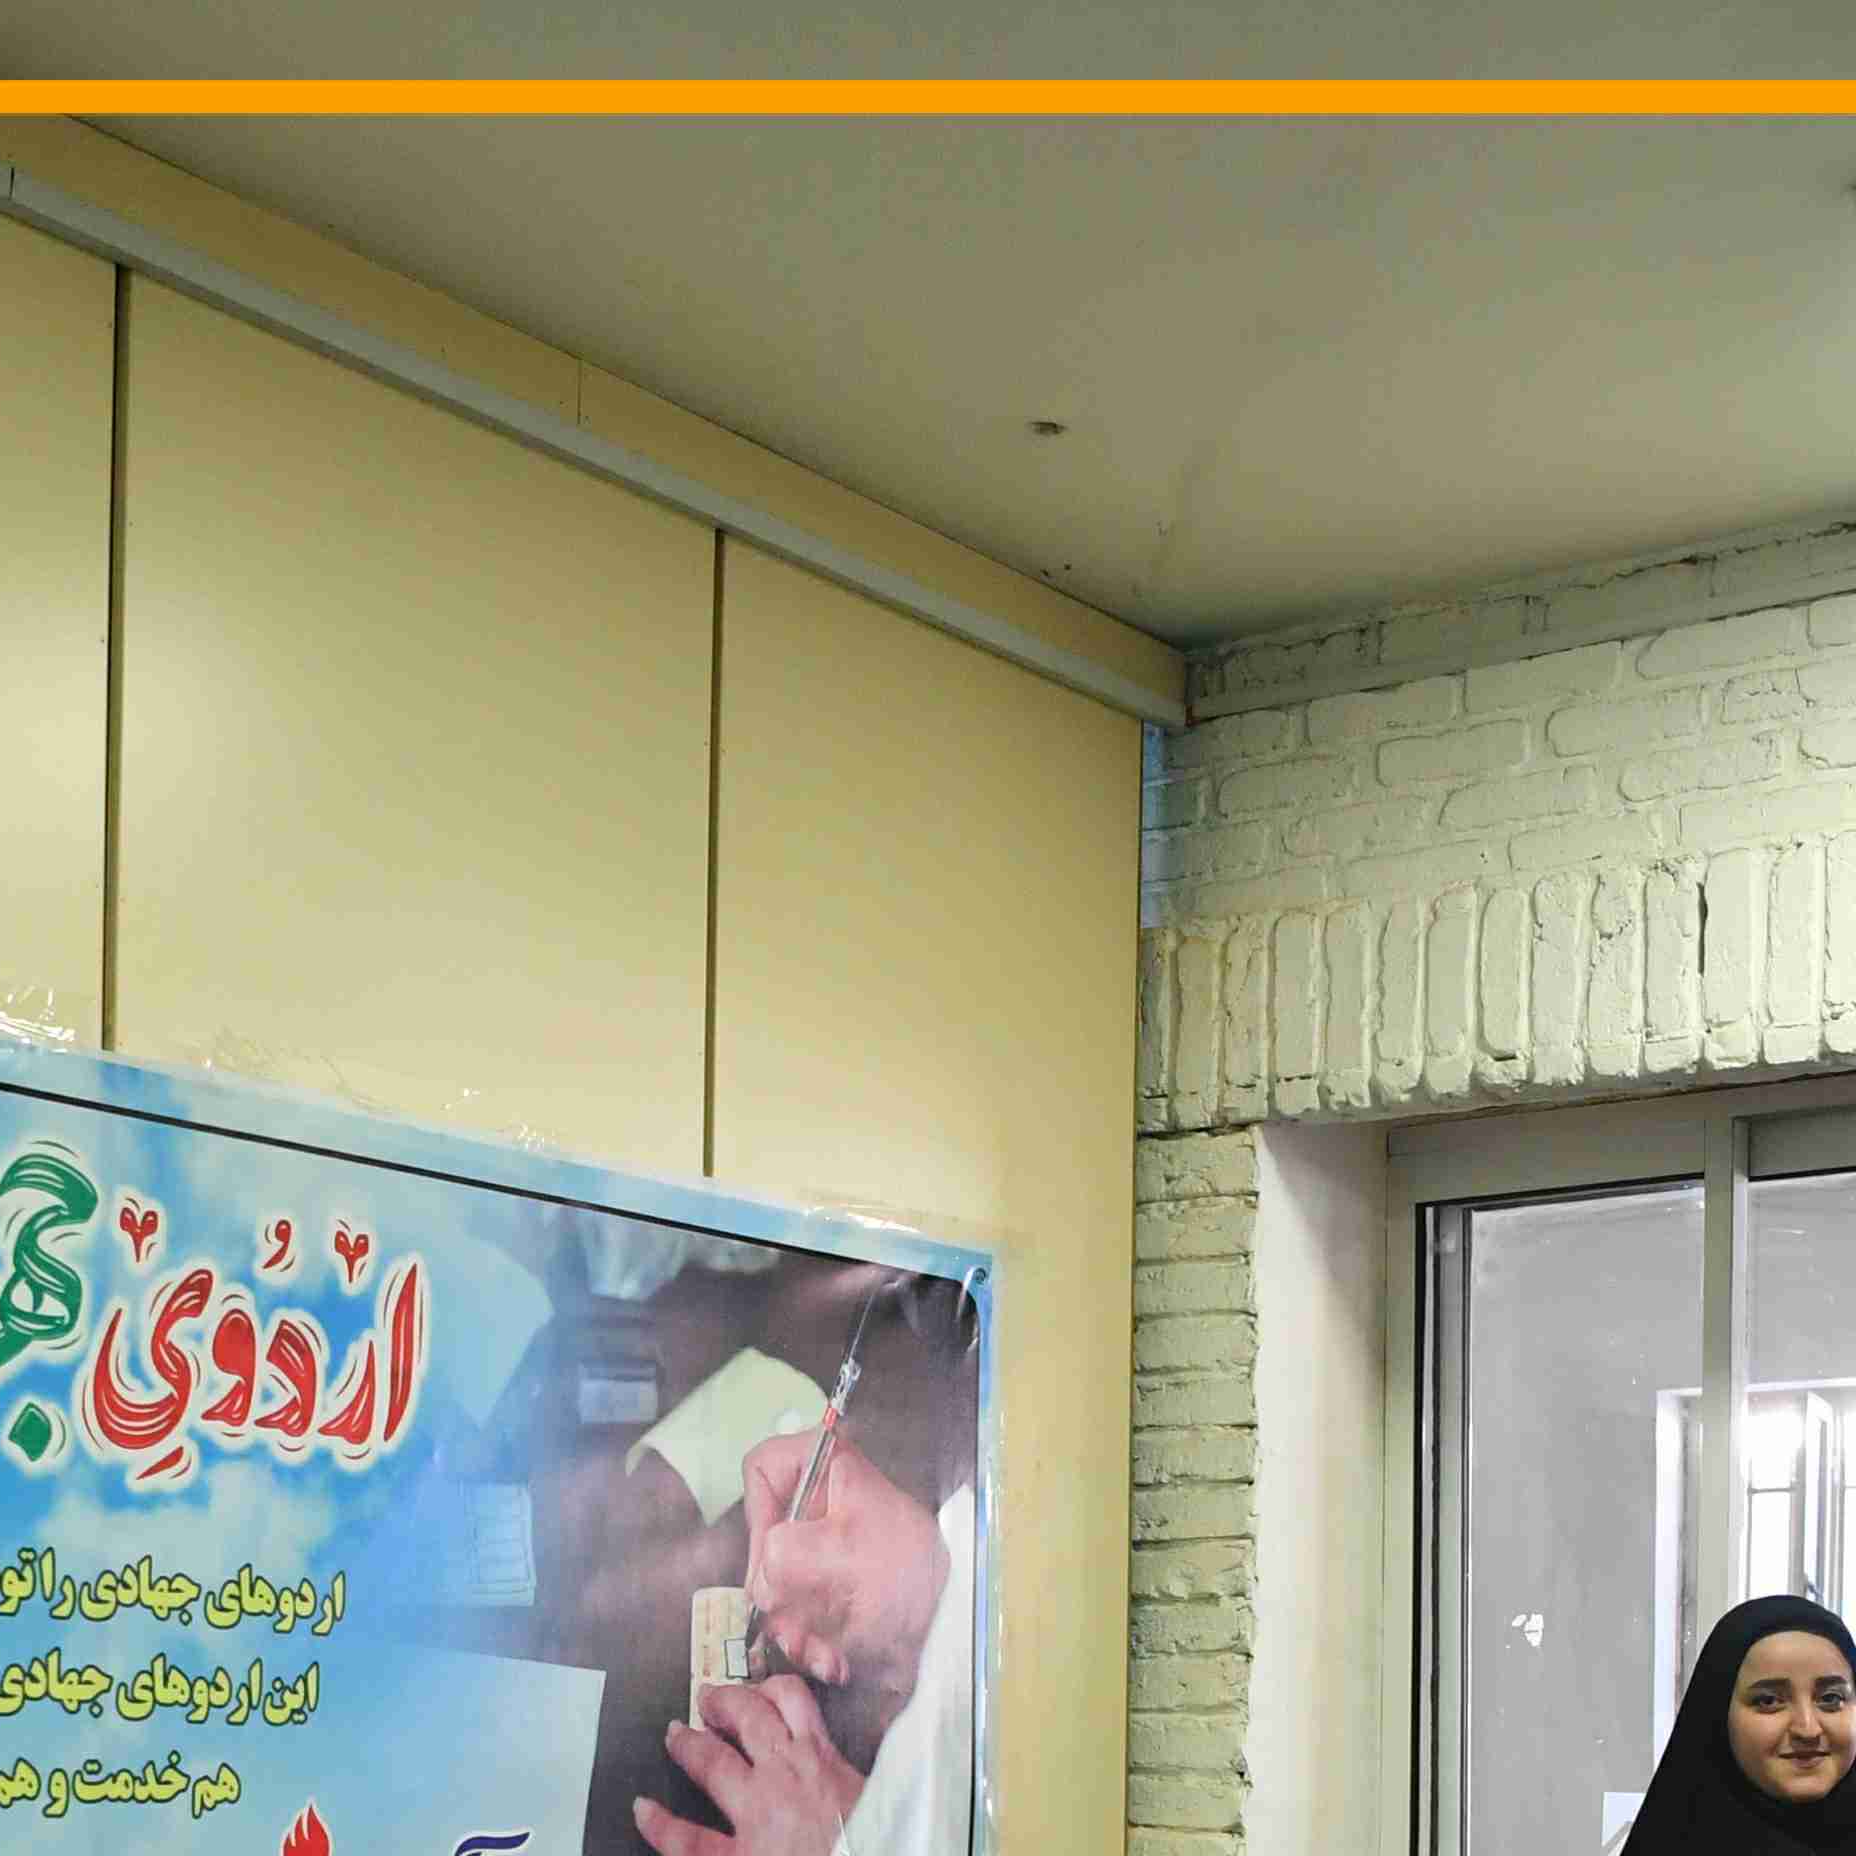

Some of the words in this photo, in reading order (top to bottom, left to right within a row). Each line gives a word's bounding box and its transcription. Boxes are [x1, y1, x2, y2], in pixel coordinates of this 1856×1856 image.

[40, 1547, 76, 1619] را
[79, 1555, 201, 1626] جهادی
[204, 1564, 345, 1635] اردوهای
[116, 1652, 263, 1725] اردوهای
[263, 1661, 319, 1725] این
[43, 1769, 69, 1817] و
[72, 1750, 190, 1803] خدمت
[192, 1763, 241, 1819] هم
